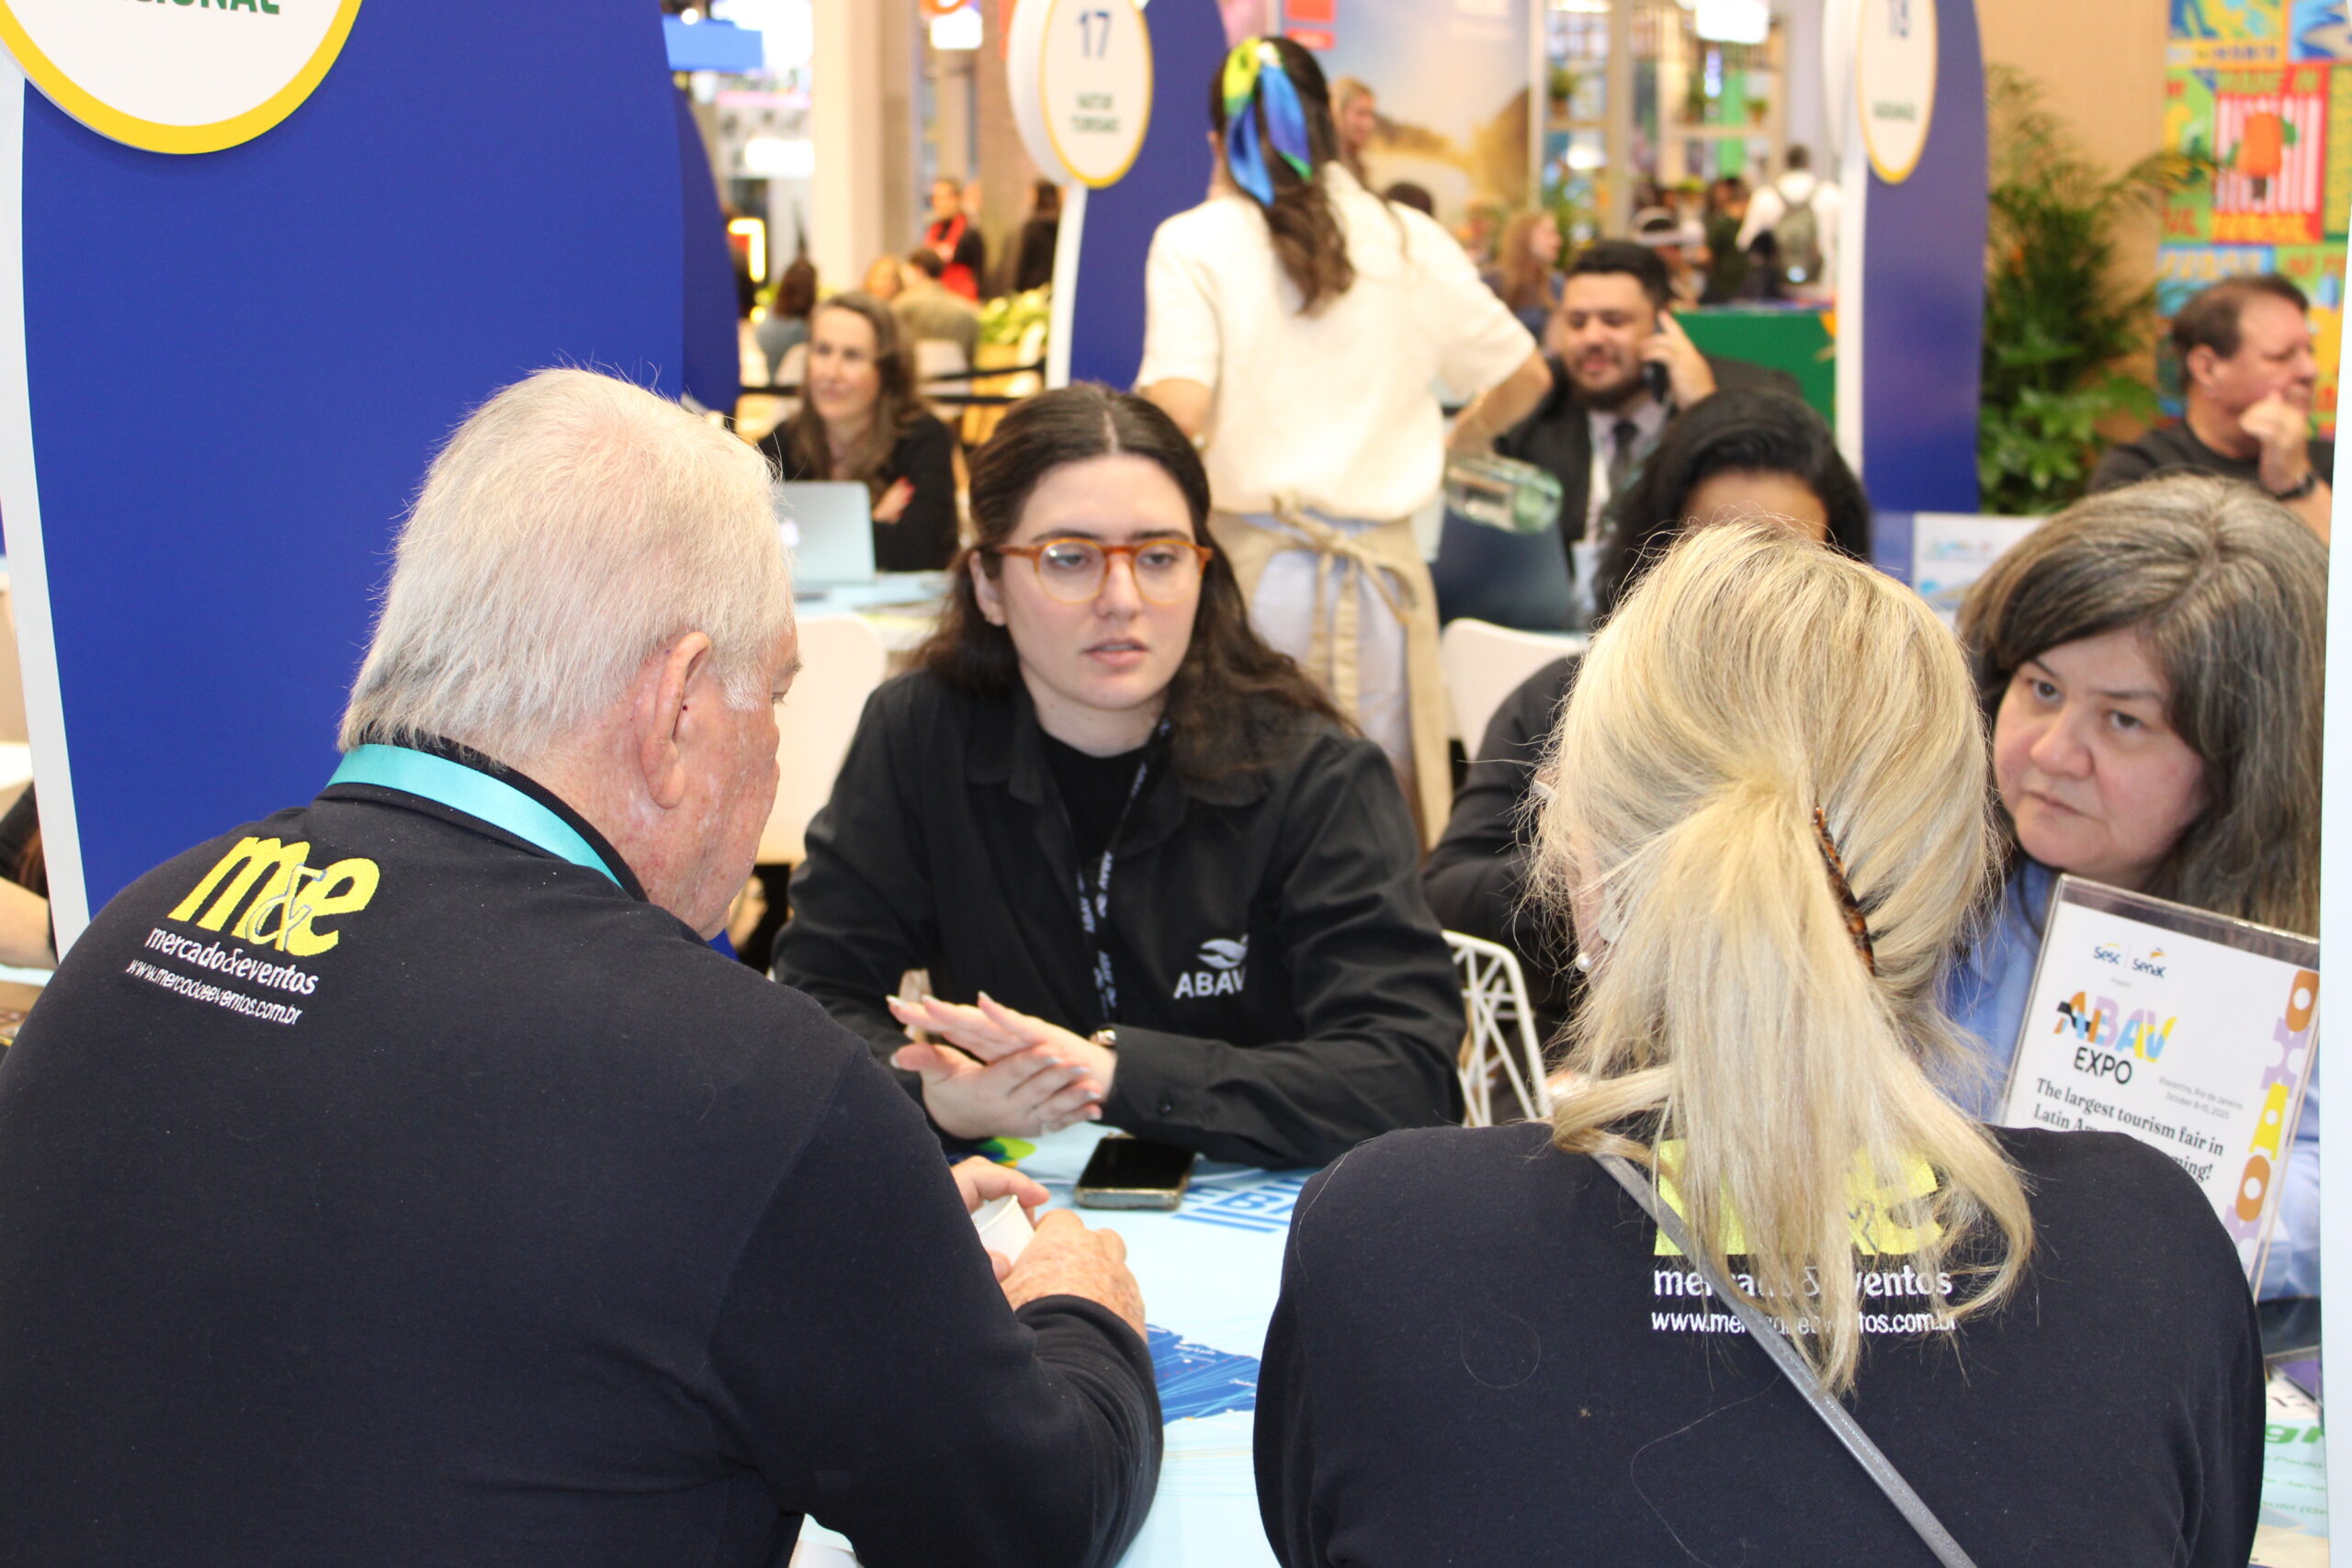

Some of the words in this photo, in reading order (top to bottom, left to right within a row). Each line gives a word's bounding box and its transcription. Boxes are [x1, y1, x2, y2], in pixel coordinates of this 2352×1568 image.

[1079, 10, 1110, 58] 17
[167, 837, 380, 956] m&e
[125, 959, 303, 1025] www.mercadoeeventos.com.br
[143, 927, 320, 996] mercado&eventos
[1173, 969, 1246, 999] ABAV
[2053, 991, 2178, 1063] ABAV
[2074, 1045, 2132, 1085] EXPO
[2033, 1103, 2071, 1129] Latin
[2037, 1077, 2062, 1100] The
[2064, 1087, 2114, 1118] largest
[2118, 1108, 2176, 1140] tourism
[2178, 1126, 2207, 1150] fair
[2209, 1137, 2224, 1156] in
